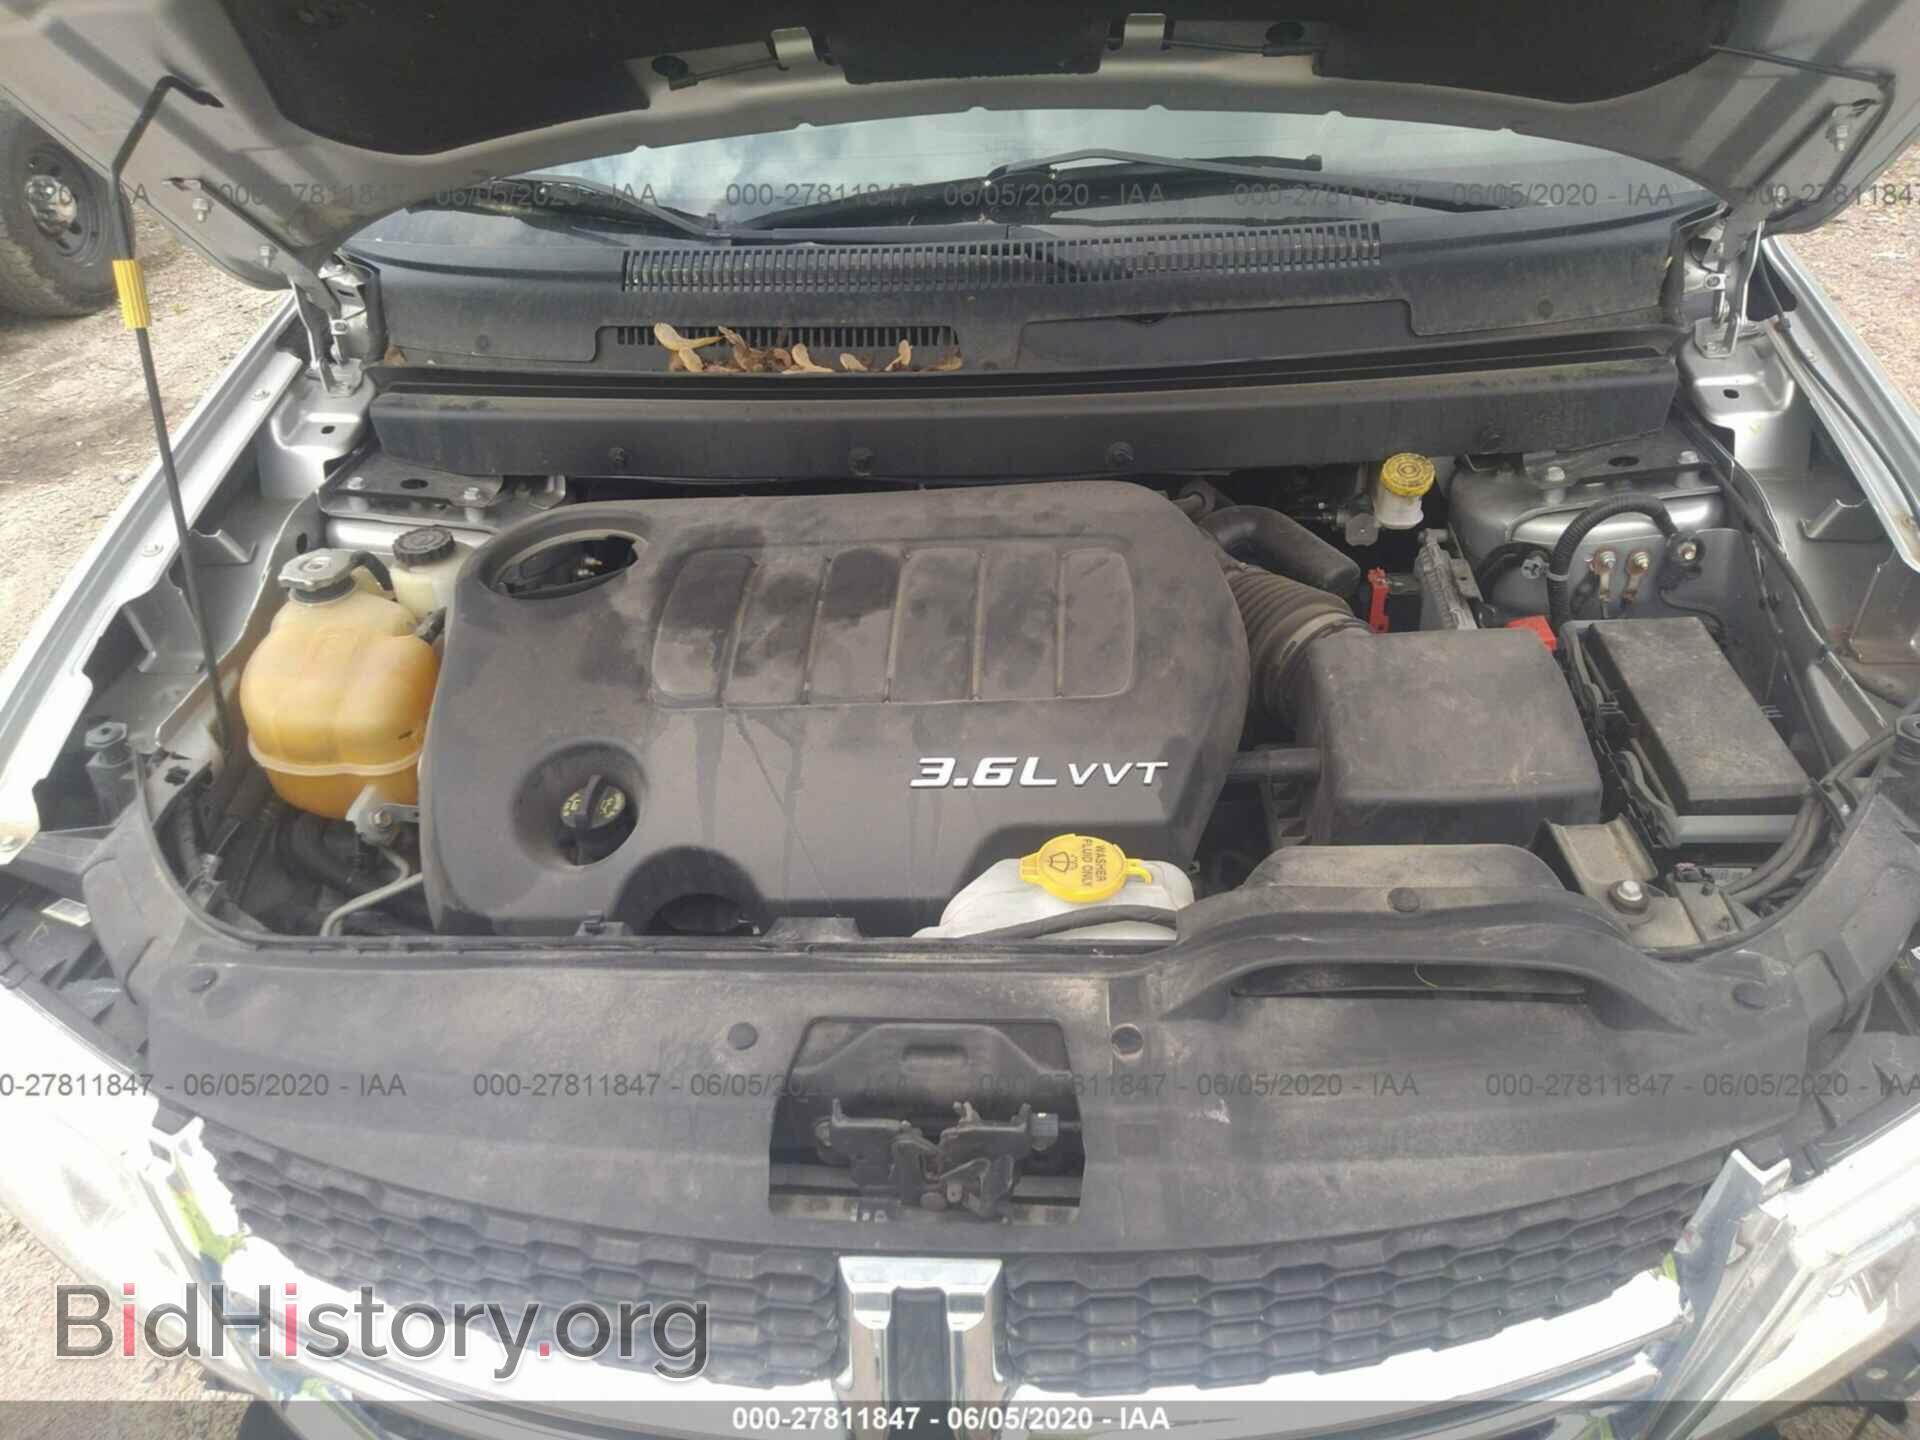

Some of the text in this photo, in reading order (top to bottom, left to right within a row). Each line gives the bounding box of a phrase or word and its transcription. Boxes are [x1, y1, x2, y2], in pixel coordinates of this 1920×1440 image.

[909, 757, 1169, 789] 3.6L VVT
[1081, 839, 1093, 887] FLUID ONLY
[1095, 845, 1106, 881] WASHER
